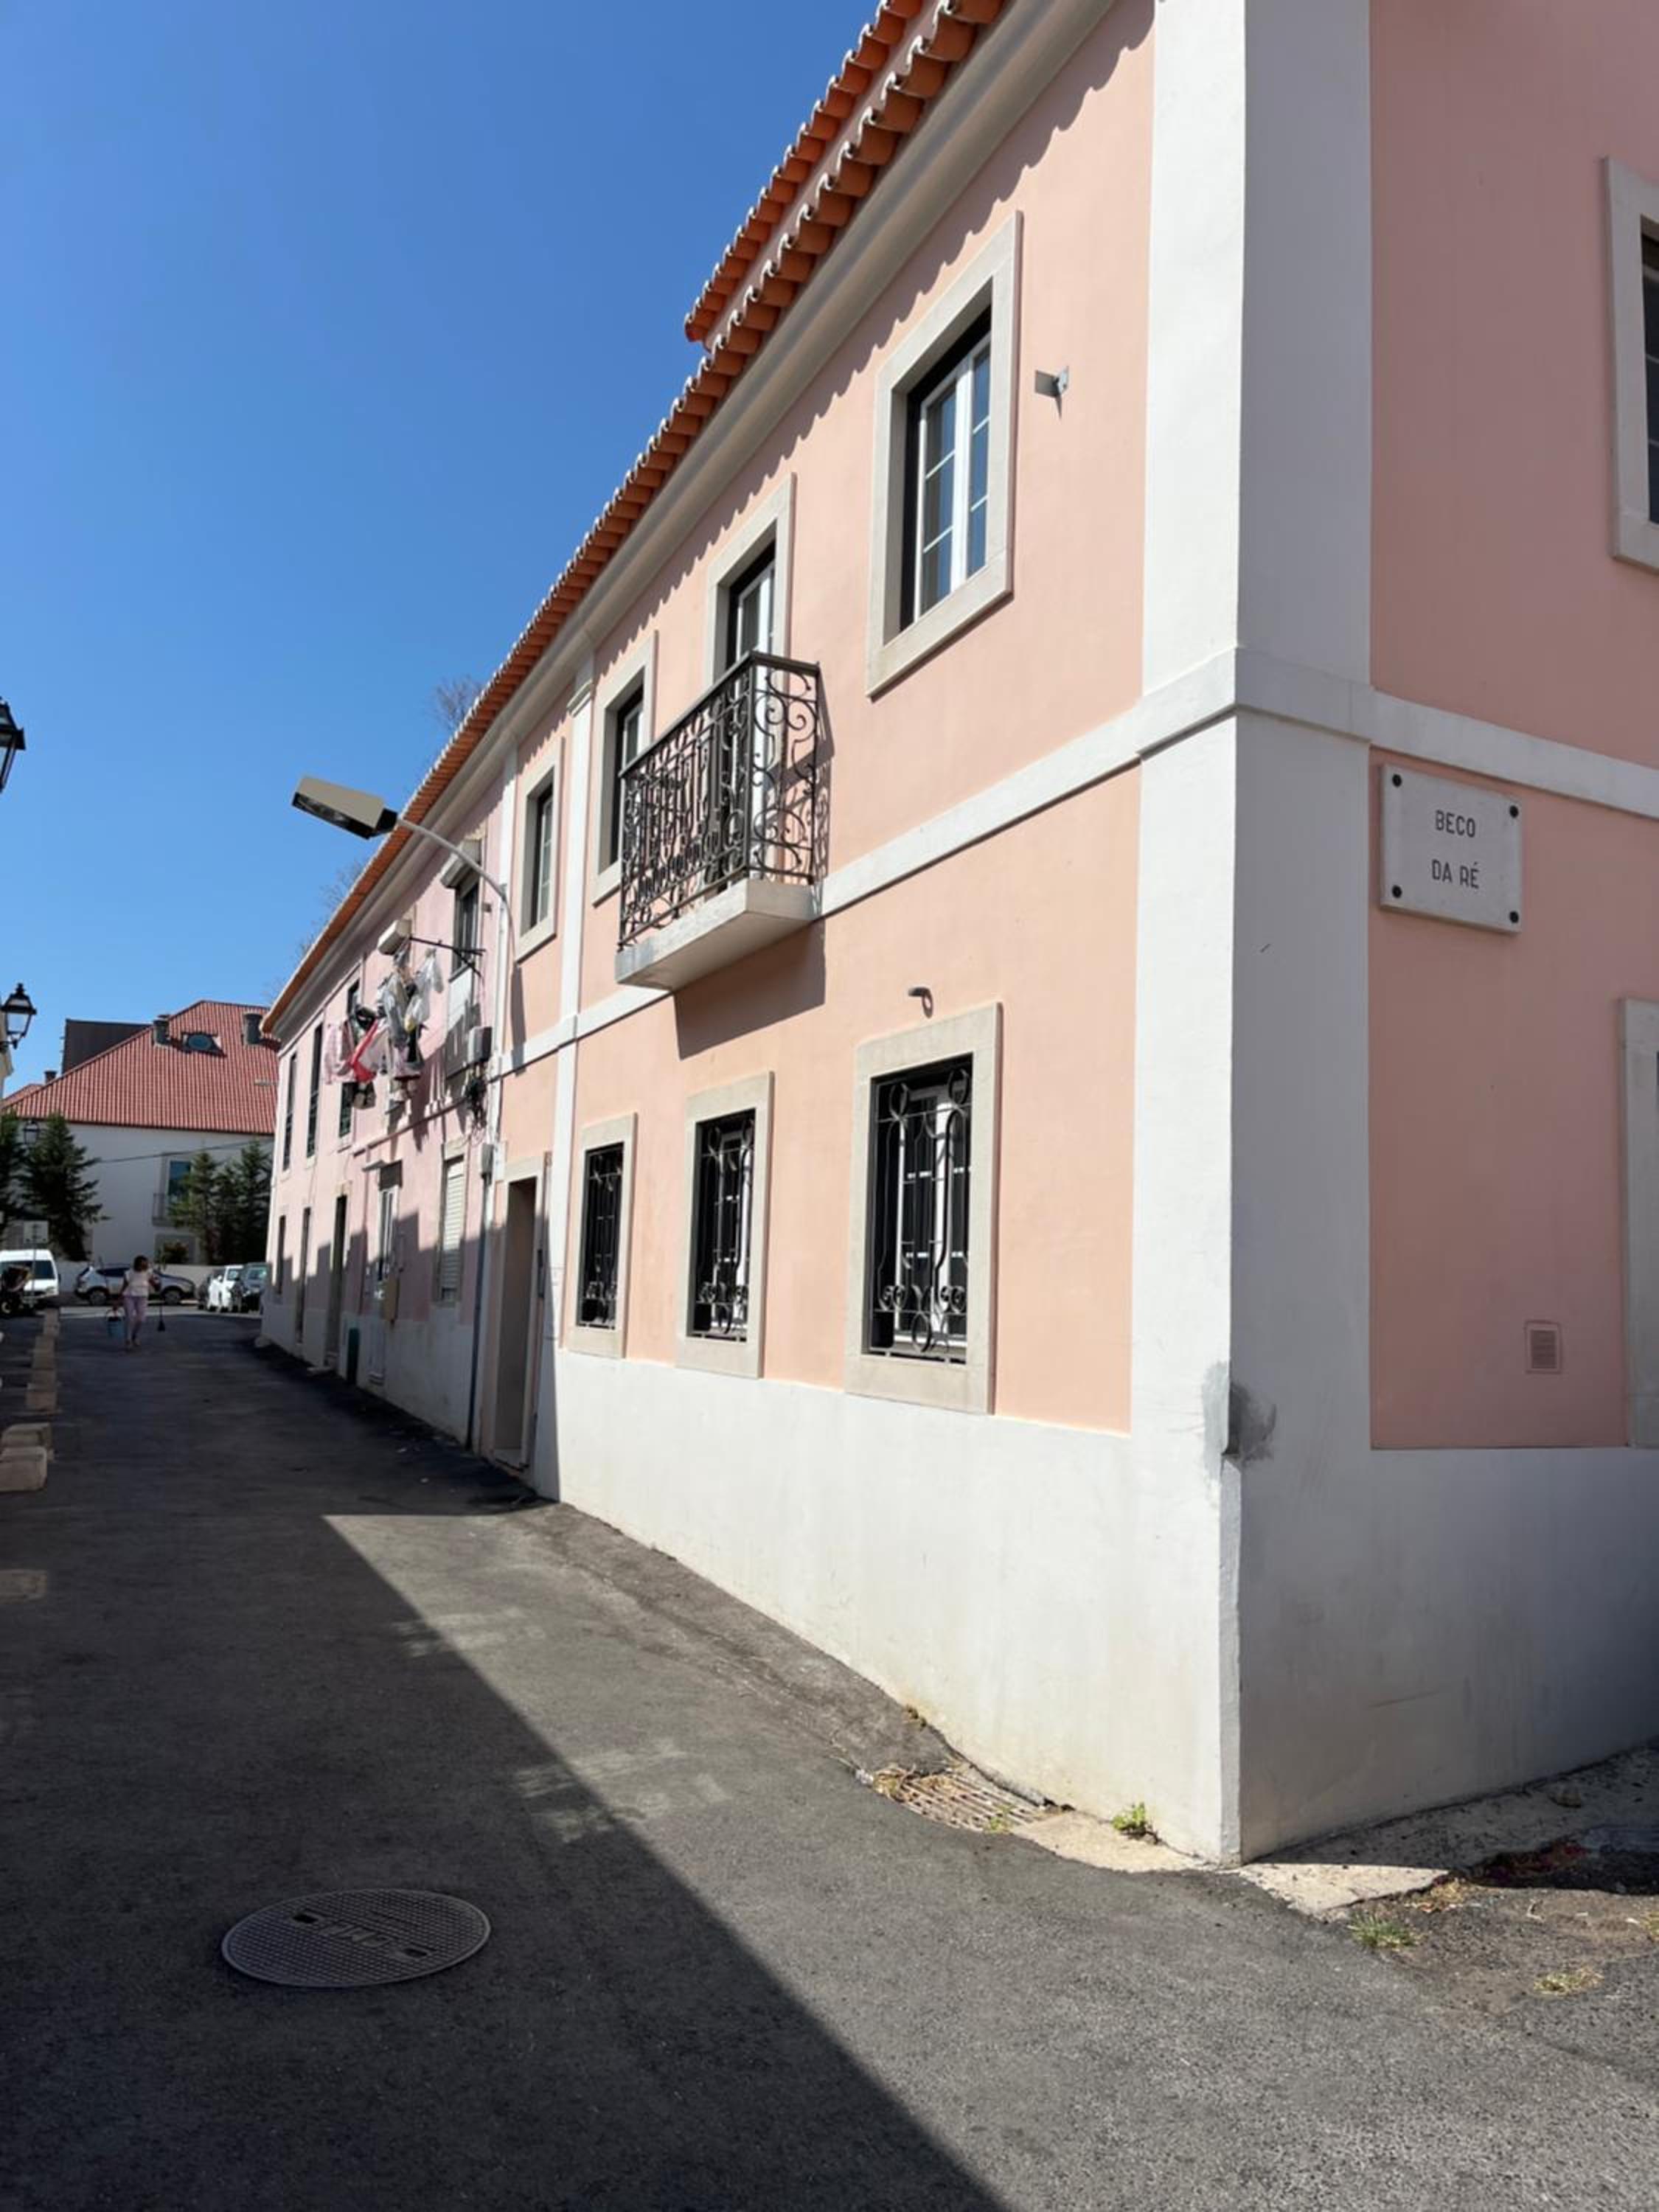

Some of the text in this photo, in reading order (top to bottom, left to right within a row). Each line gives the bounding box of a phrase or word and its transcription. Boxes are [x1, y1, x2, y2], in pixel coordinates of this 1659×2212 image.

[1436, 810, 1475, 837] BECO
[1432, 859, 1479, 888] DA RÉ
